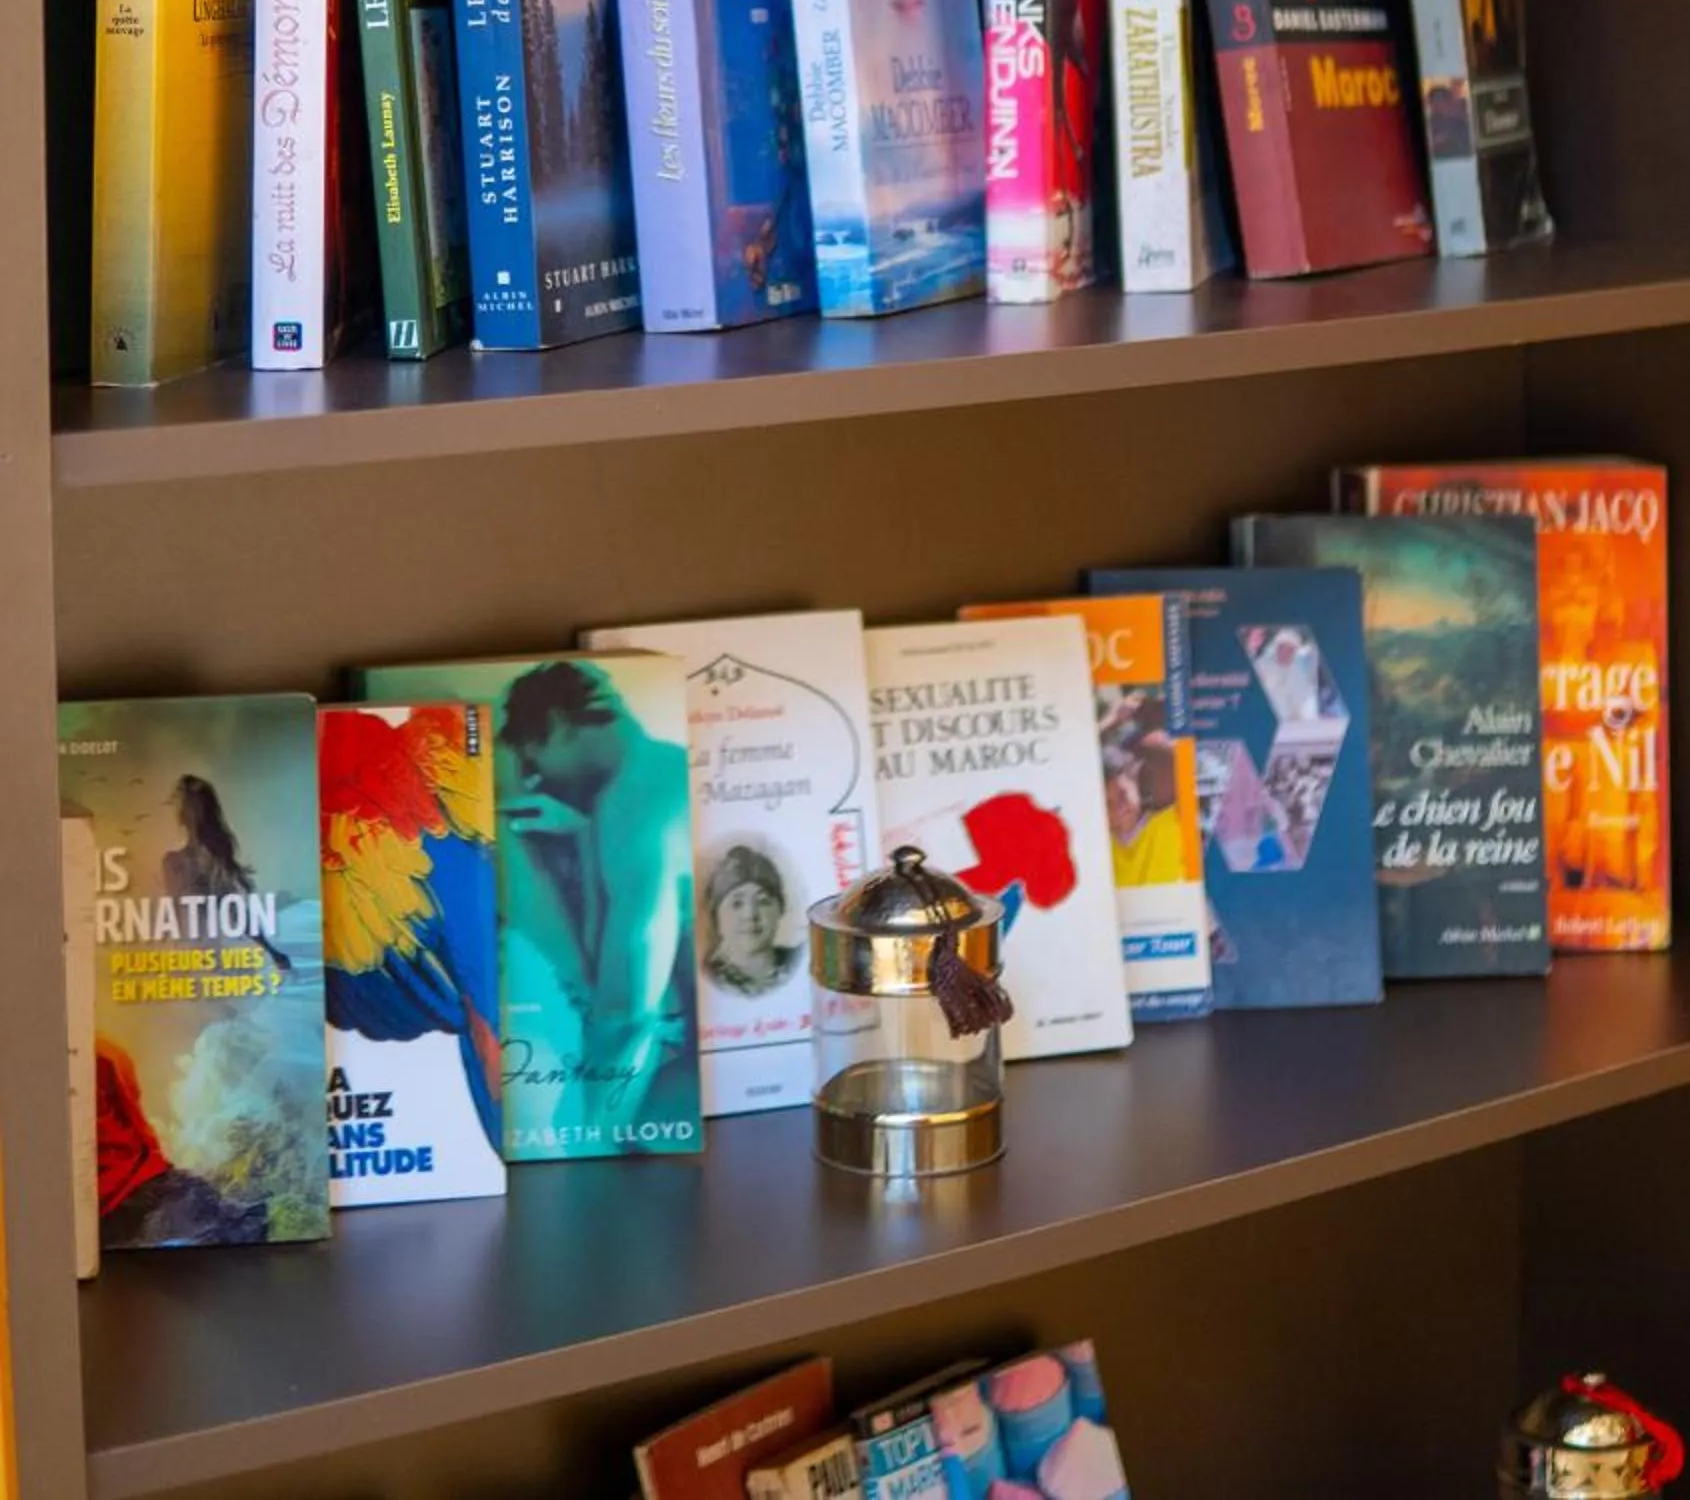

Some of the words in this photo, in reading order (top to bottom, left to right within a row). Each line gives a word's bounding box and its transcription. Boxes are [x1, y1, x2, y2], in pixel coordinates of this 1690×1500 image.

[1272, 7, 1319, 32] DANIEL
[1319, 7, 1389, 32] EASTERMAN
[825, 29, 849, 151] MACOMBER
[1124, 7, 1163, 180] ZARATHUSTRA
[1309, 54, 1400, 109] Maroc
[380, 90, 396, 149] Launay
[475, 96, 498, 205] STUART
[496, 74, 519, 224] HARRISON
[383, 153, 402, 224] Elisabeth
[544, 263, 597, 290] STUART
[477, 302, 535, 312] MICHEL
[1572, 487, 1659, 545] JACQ
[868, 673, 1038, 715] SEXUALITE
[870, 720, 892, 749] T
[900, 704, 1061, 747] DISCOURS
[874, 750, 917, 782] AU
[928, 739, 1050, 777] MAROC
[1544, 741, 1573, 792] e
[1586, 724, 1659, 792] Nil
[1372, 803, 1394, 828] e
[1399, 788, 1483, 828] chien
[1481, 787, 1538, 832] fou
[1381, 831, 1424, 869] de
[1424, 830, 1458, 868] la
[1462, 832, 1540, 868] reine
[95, 893, 277, 944] RNATION
[110, 948, 218, 974] PLUSIEURS
[220, 947, 265, 970] VIES
[111, 980, 137, 1002] EN
[138, 973, 197, 1001] MÊME
[201, 975, 266, 998] TEMPS
[612, 1120, 696, 1143] LLOYD
[328, 1146, 434, 1179] LITUDE
